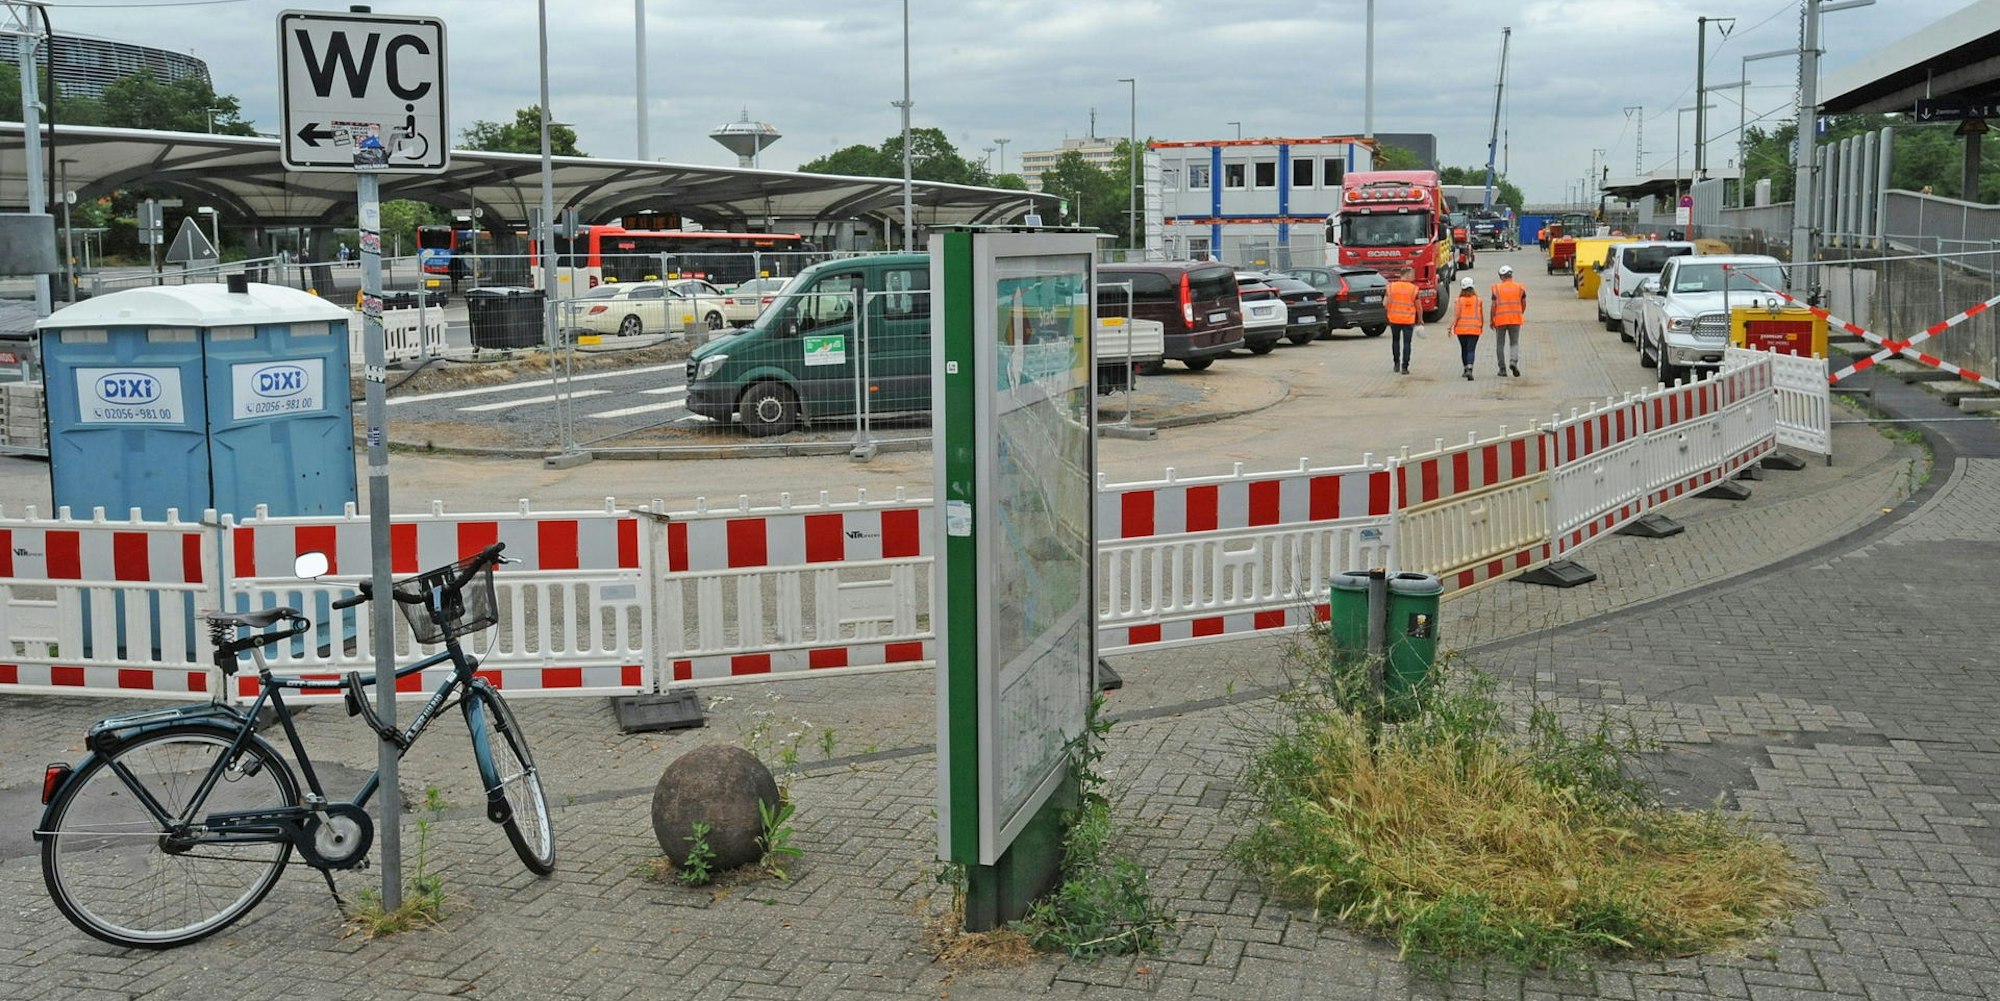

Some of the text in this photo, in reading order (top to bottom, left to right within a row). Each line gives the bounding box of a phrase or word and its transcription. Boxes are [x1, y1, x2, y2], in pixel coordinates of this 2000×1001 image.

[295, 29, 431, 101] WC
[302, 398, 313, 408] 00
[159, 409, 172, 420] 00
